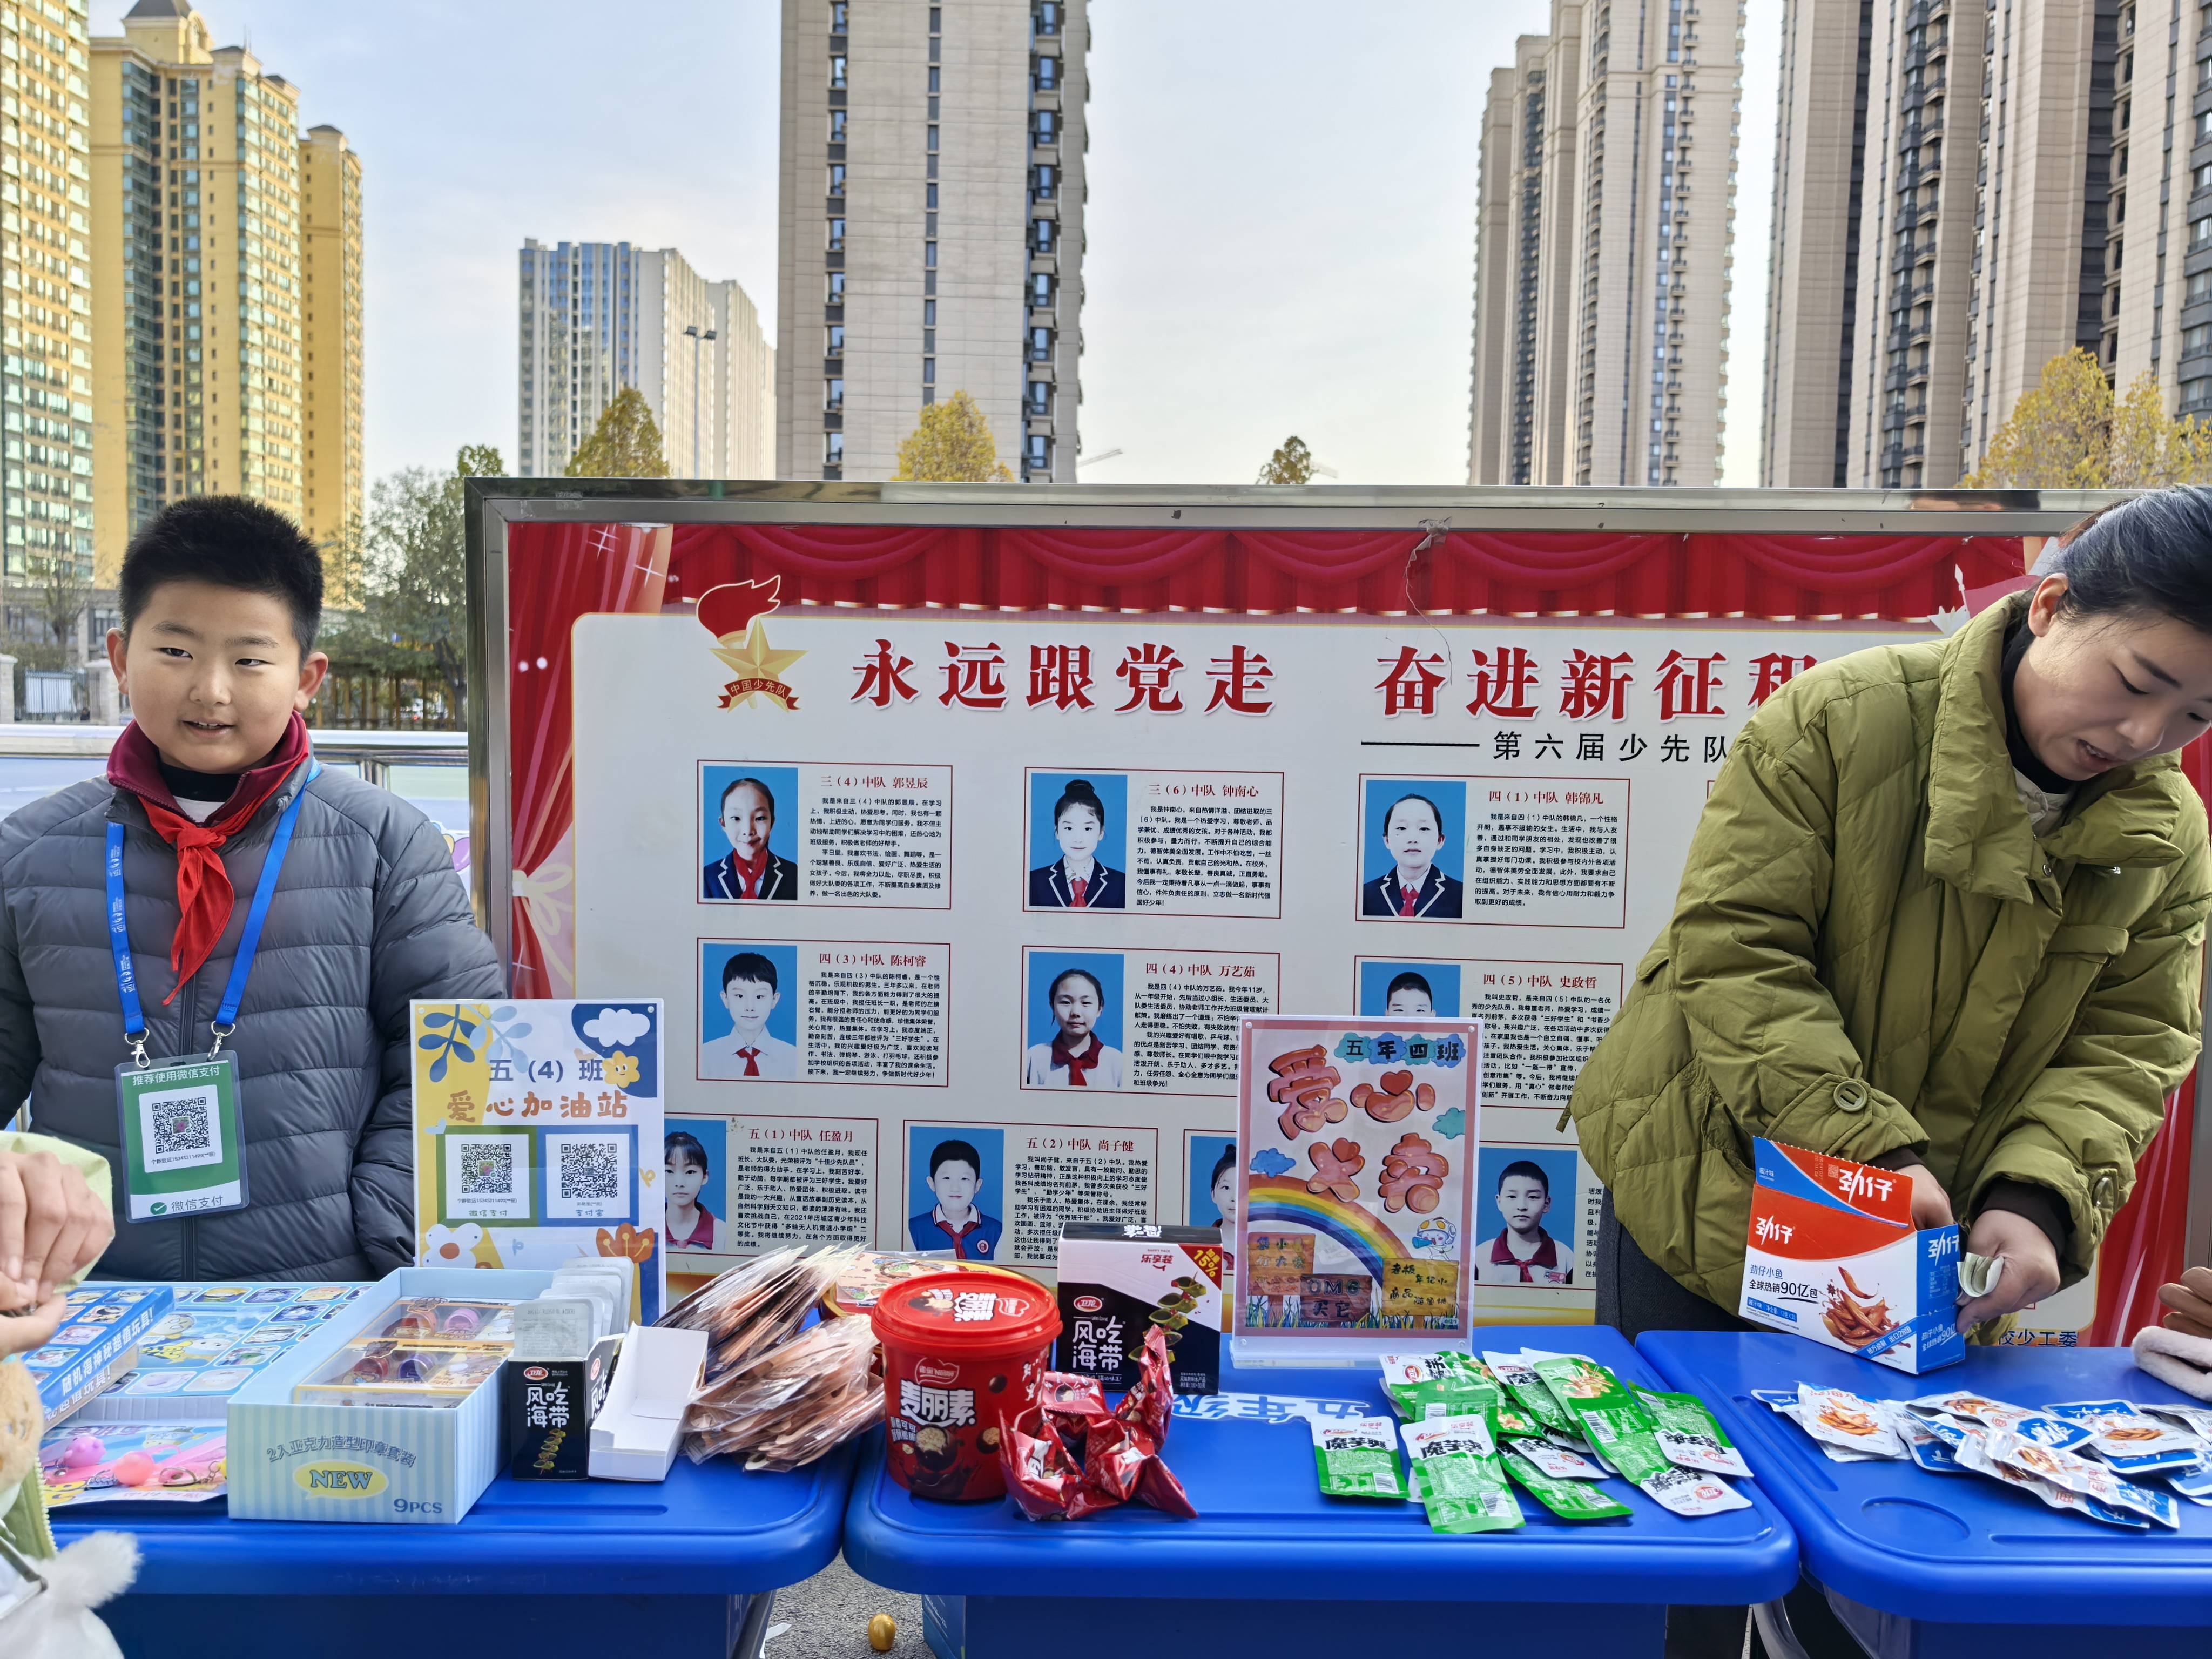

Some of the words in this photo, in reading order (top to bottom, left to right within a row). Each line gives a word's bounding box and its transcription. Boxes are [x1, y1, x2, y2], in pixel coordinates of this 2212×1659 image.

[851, 639, 1276, 714] 永远跟党走
[731, 679, 786, 698] 中国少先队
[1492, 731, 1728, 763] 第六届少先队
[821, 776, 886, 788] 三（4）中队
[893, 777, 928, 788] 郭昱辰
[1149, 784, 1215, 796] 三（6）中队
[1222, 785, 1259, 797] 钟南心
[1489, 791, 1559, 804] 四（1）中队
[1566, 792, 1603, 804] 韩锦凡
[820, 953, 884, 966] 四（3）中队
[891, 955, 926, 967] 陈柯睿
[1146, 963, 1212, 976] 四（4）中队
[1218, 965, 1255, 977] 万艺茹
[1483, 974, 1552, 987] 四（5）中队
[1560, 976, 1597, 988] 史政哲
[1345, 1038, 1460, 1062] 五年四班
[132, 1065, 220, 1086] 推荐使用微信支付
[447, 1090, 628, 1123] 爱心加油站
[749, 1129, 812, 1141] 五（1）中队
[819, 1130, 853, 1142] 任盈月
[1027, 1137, 1091, 1150] 五（2）中队
[1098, 1139, 1134, 1151] 尚子健
[1838, 1165, 1893, 1204] 劲仔
[171, 1195, 224, 1212] 微信支付
[1755, 1215, 1793, 1246] 劲仔
[1193, 1250, 1218, 1277] 15%
[1750, 1264, 1783, 1280] 劲仔小鱼
[1307, 1278, 1361, 1296] OMG
[1748, 1279, 1818, 1299] 全球热销90亿包
[1312, 1299, 1351, 1319] 买它
[1073, 1316, 1123, 1344] 风吃
[1073, 1341, 1123, 1371] 海带
[525, 1381, 569, 1405] 风吃
[900, 1379, 976, 1427] 麦丽素
[527, 1404, 570, 1428] 海带
[1325, 1437, 1388, 1451] 魔芋爽
[309, 1469, 373, 1491] NEW
[393, 1498, 443, 1514] 9PCS
